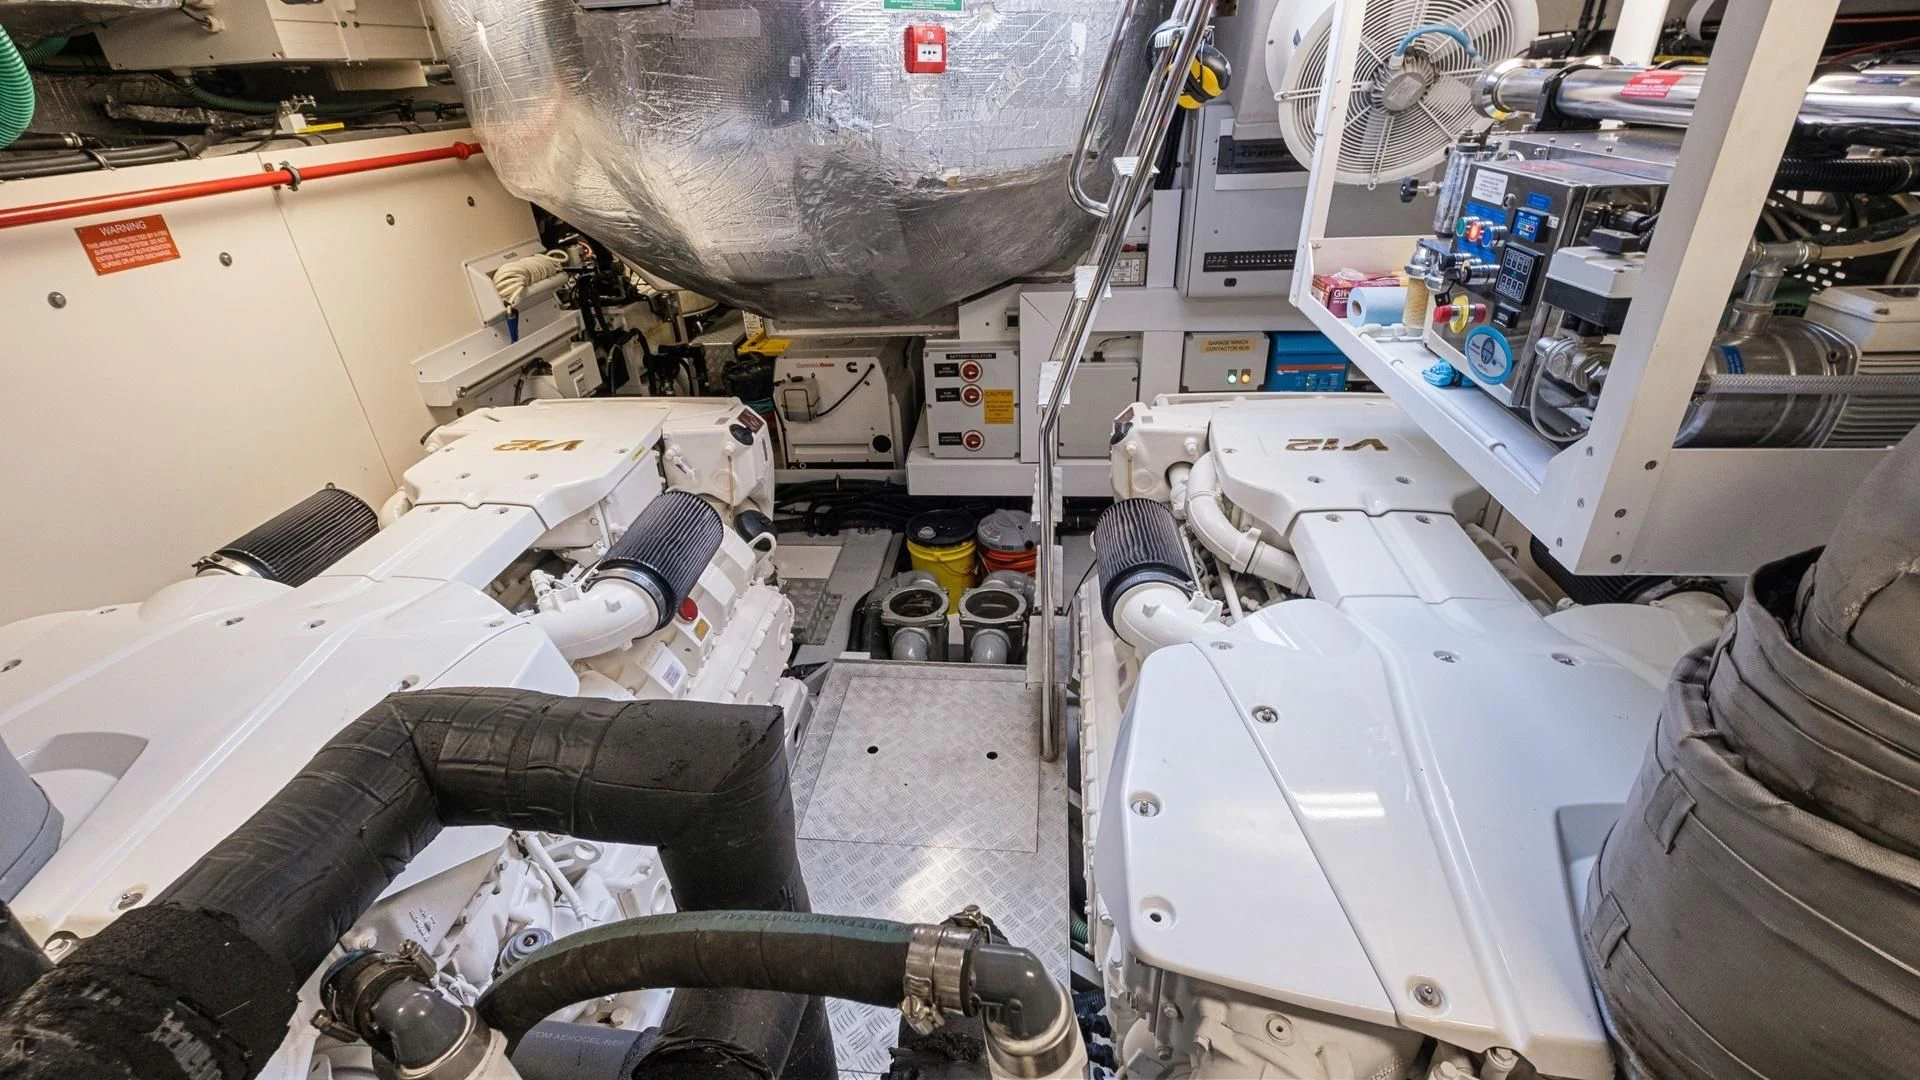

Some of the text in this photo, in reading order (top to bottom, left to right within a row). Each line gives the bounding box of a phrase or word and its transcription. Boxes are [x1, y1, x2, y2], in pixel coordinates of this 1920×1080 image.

[99, 220, 147, 236] WARNING
[493, 439, 585, 451] V12
[1285, 438, 1388, 451] V12
[858, 921, 888, 931] WET
